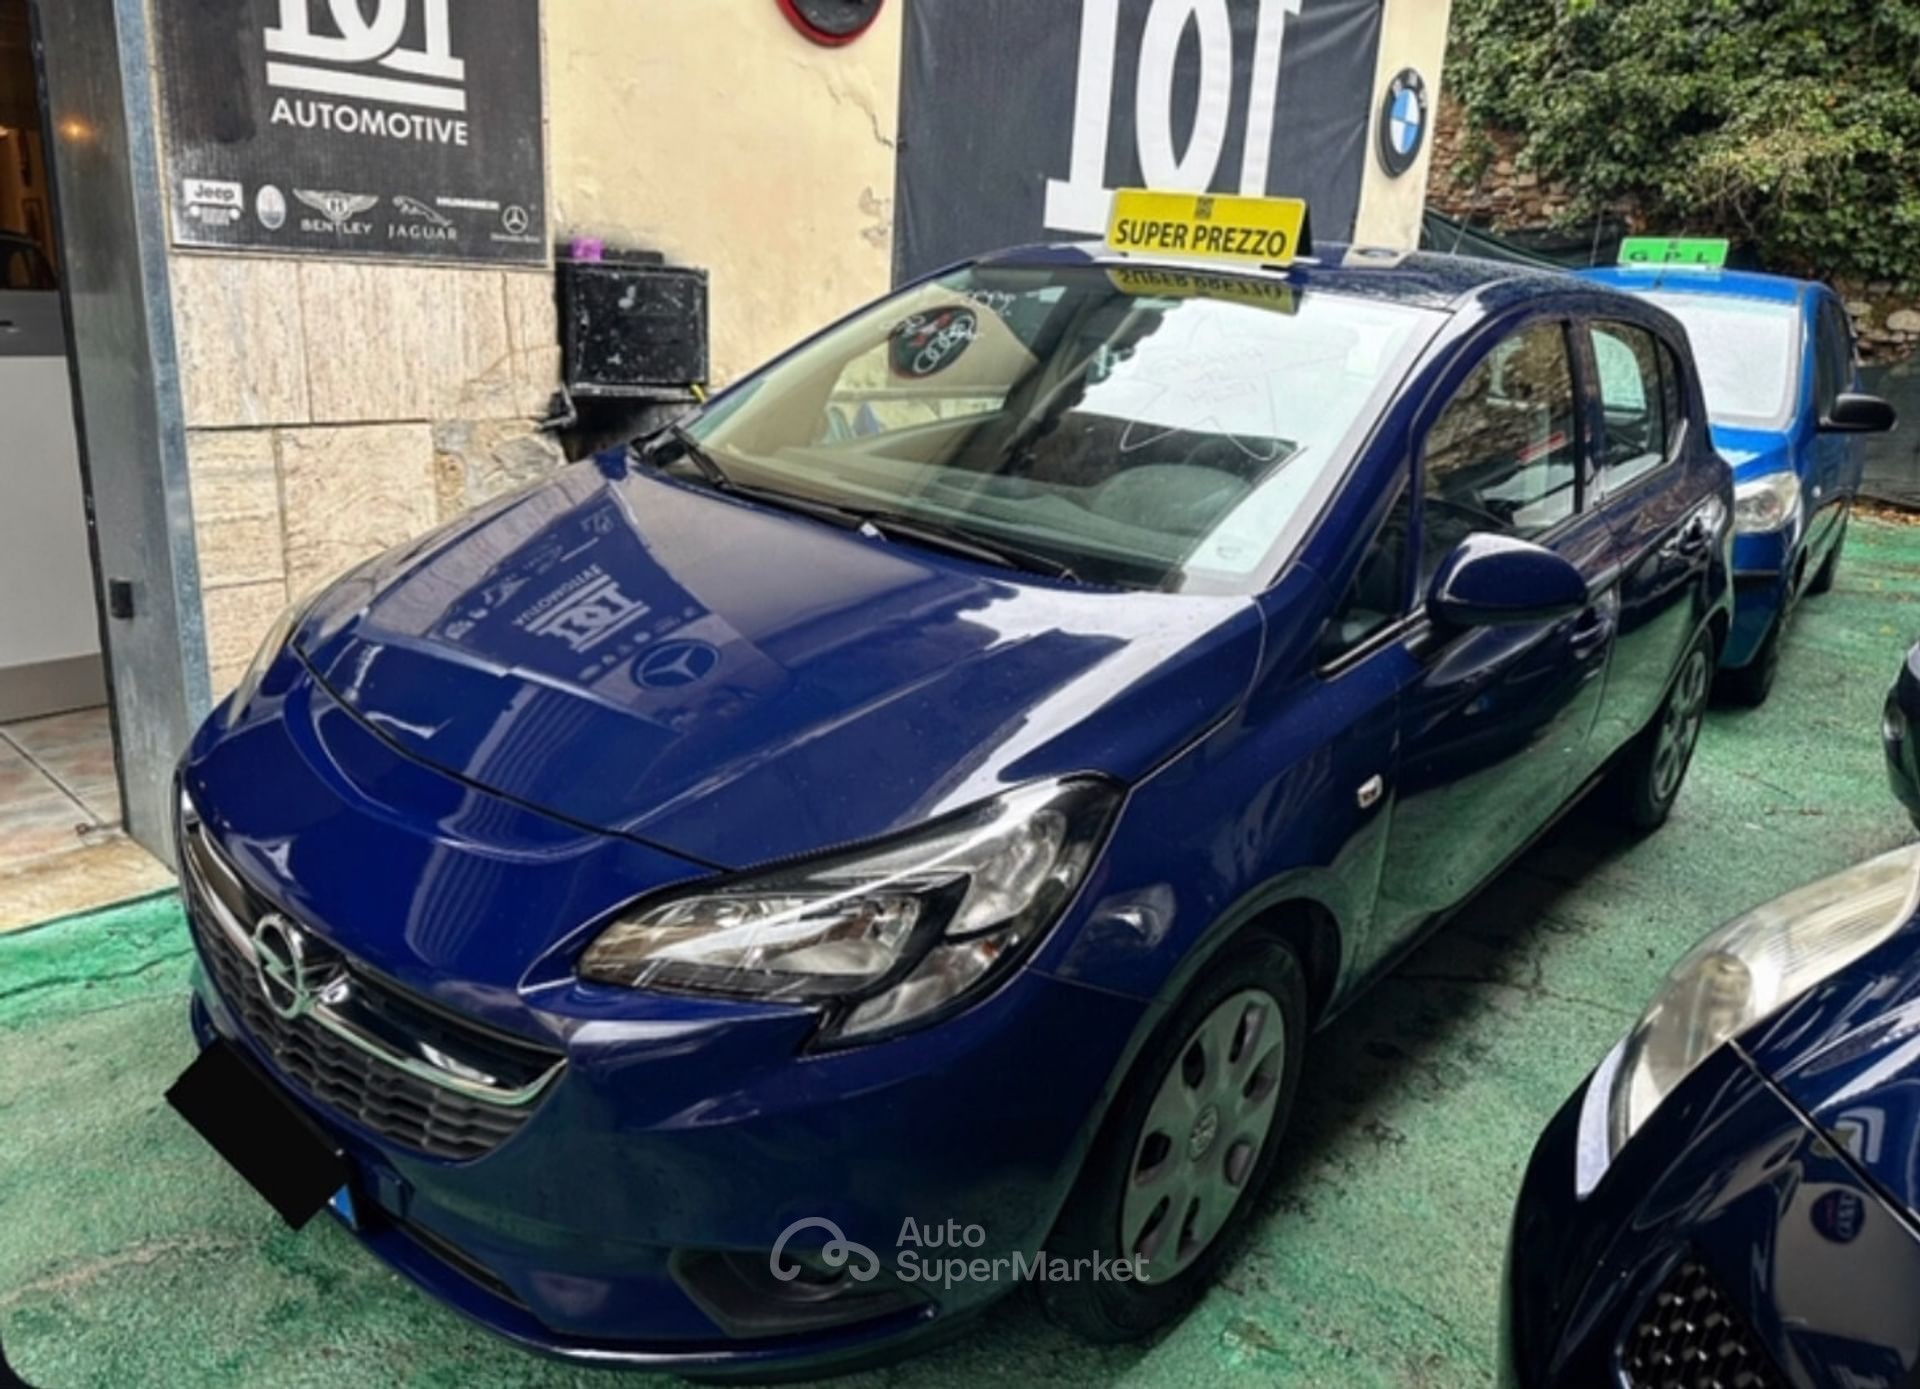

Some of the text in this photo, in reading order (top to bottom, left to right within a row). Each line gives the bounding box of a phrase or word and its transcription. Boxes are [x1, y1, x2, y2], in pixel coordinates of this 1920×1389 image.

[270, 97, 468, 146] AUTOMOTIVE
[194, 184, 235, 201] Jeep
[301, 218, 373, 236] BENTLEY
[388, 223, 458, 241] JAGUAR
[1115, 219, 1287, 258] SUPER PREZZO
